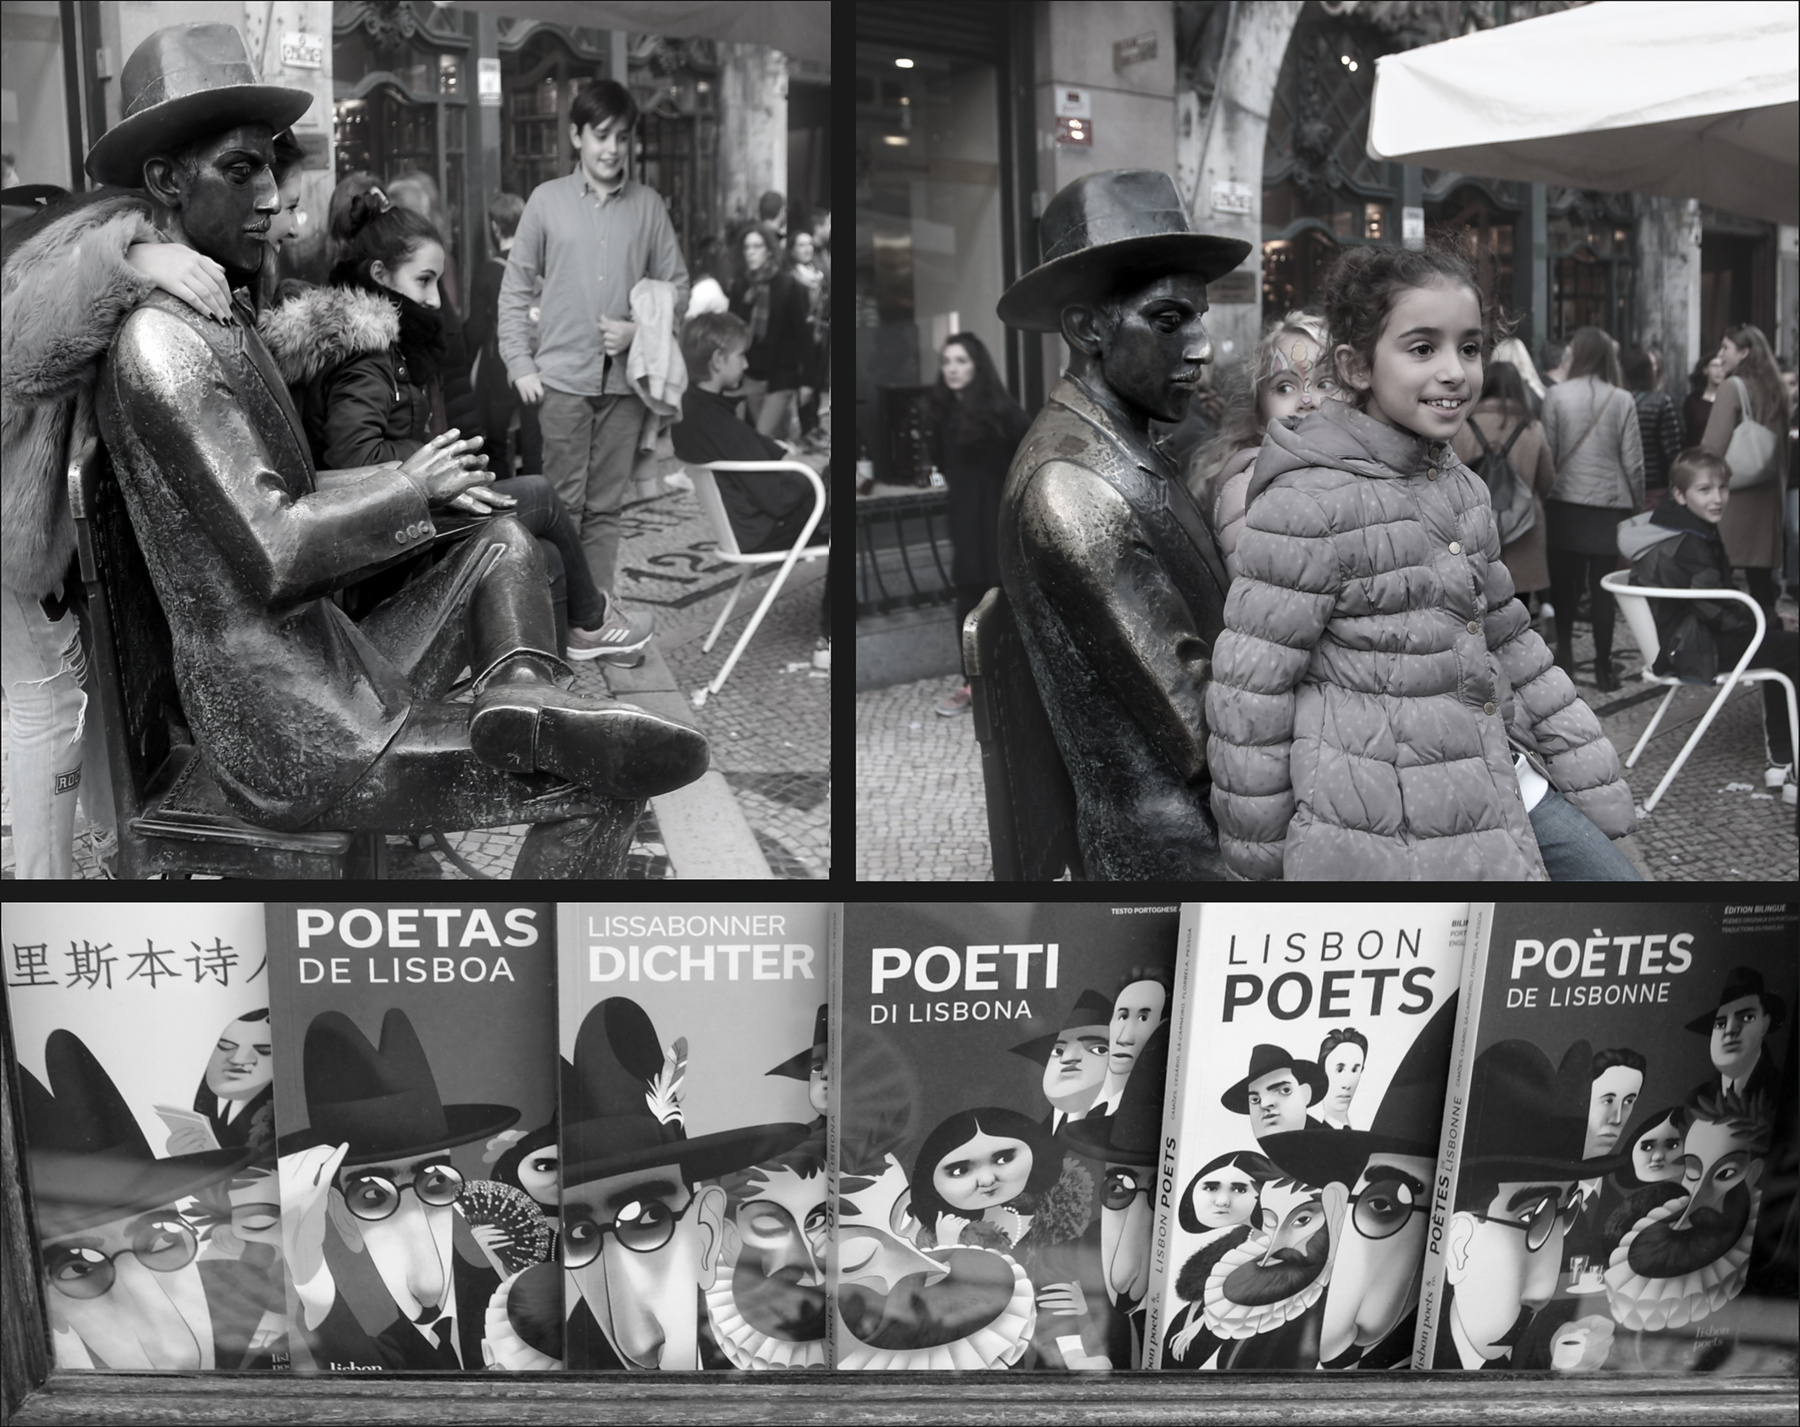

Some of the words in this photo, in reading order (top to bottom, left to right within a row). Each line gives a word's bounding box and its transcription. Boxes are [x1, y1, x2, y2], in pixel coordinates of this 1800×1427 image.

[296, 908, 539, 948] POETAS
[588, 915, 786, 938] LISSABONNER
[1134, 906, 1178, 914] PORTOGHESE
[588, 943, 814, 981] DICHTER
[1228, 928, 1422, 966] LISBON
[1511, 928, 1694, 978] POÈTES
[298, 957, 352, 984] DE
[369, 956, 516, 983] LISBOA
[871, 943, 1059, 993] POETI
[870, 1004, 898, 1024] DI
[909, 1000, 1033, 1023] LISBONA
[1222, 965, 1436, 1023] POETS
[1506, 986, 1537, 1008] DE
[1549, 981, 1671, 1005] LISBONNE
[1160, 1137, 1177, 1208] POETS
[1430, 1175, 1450, 1255] POÈTES
[1444, 1096, 1463, 1172] LISBONNE
[827, 1177, 835, 1243] POETI
[1155, 1214, 1168, 1274] LISBON
[1149, 1307, 1159, 1347] poets
[1423, 1291, 1434, 1329] poets
